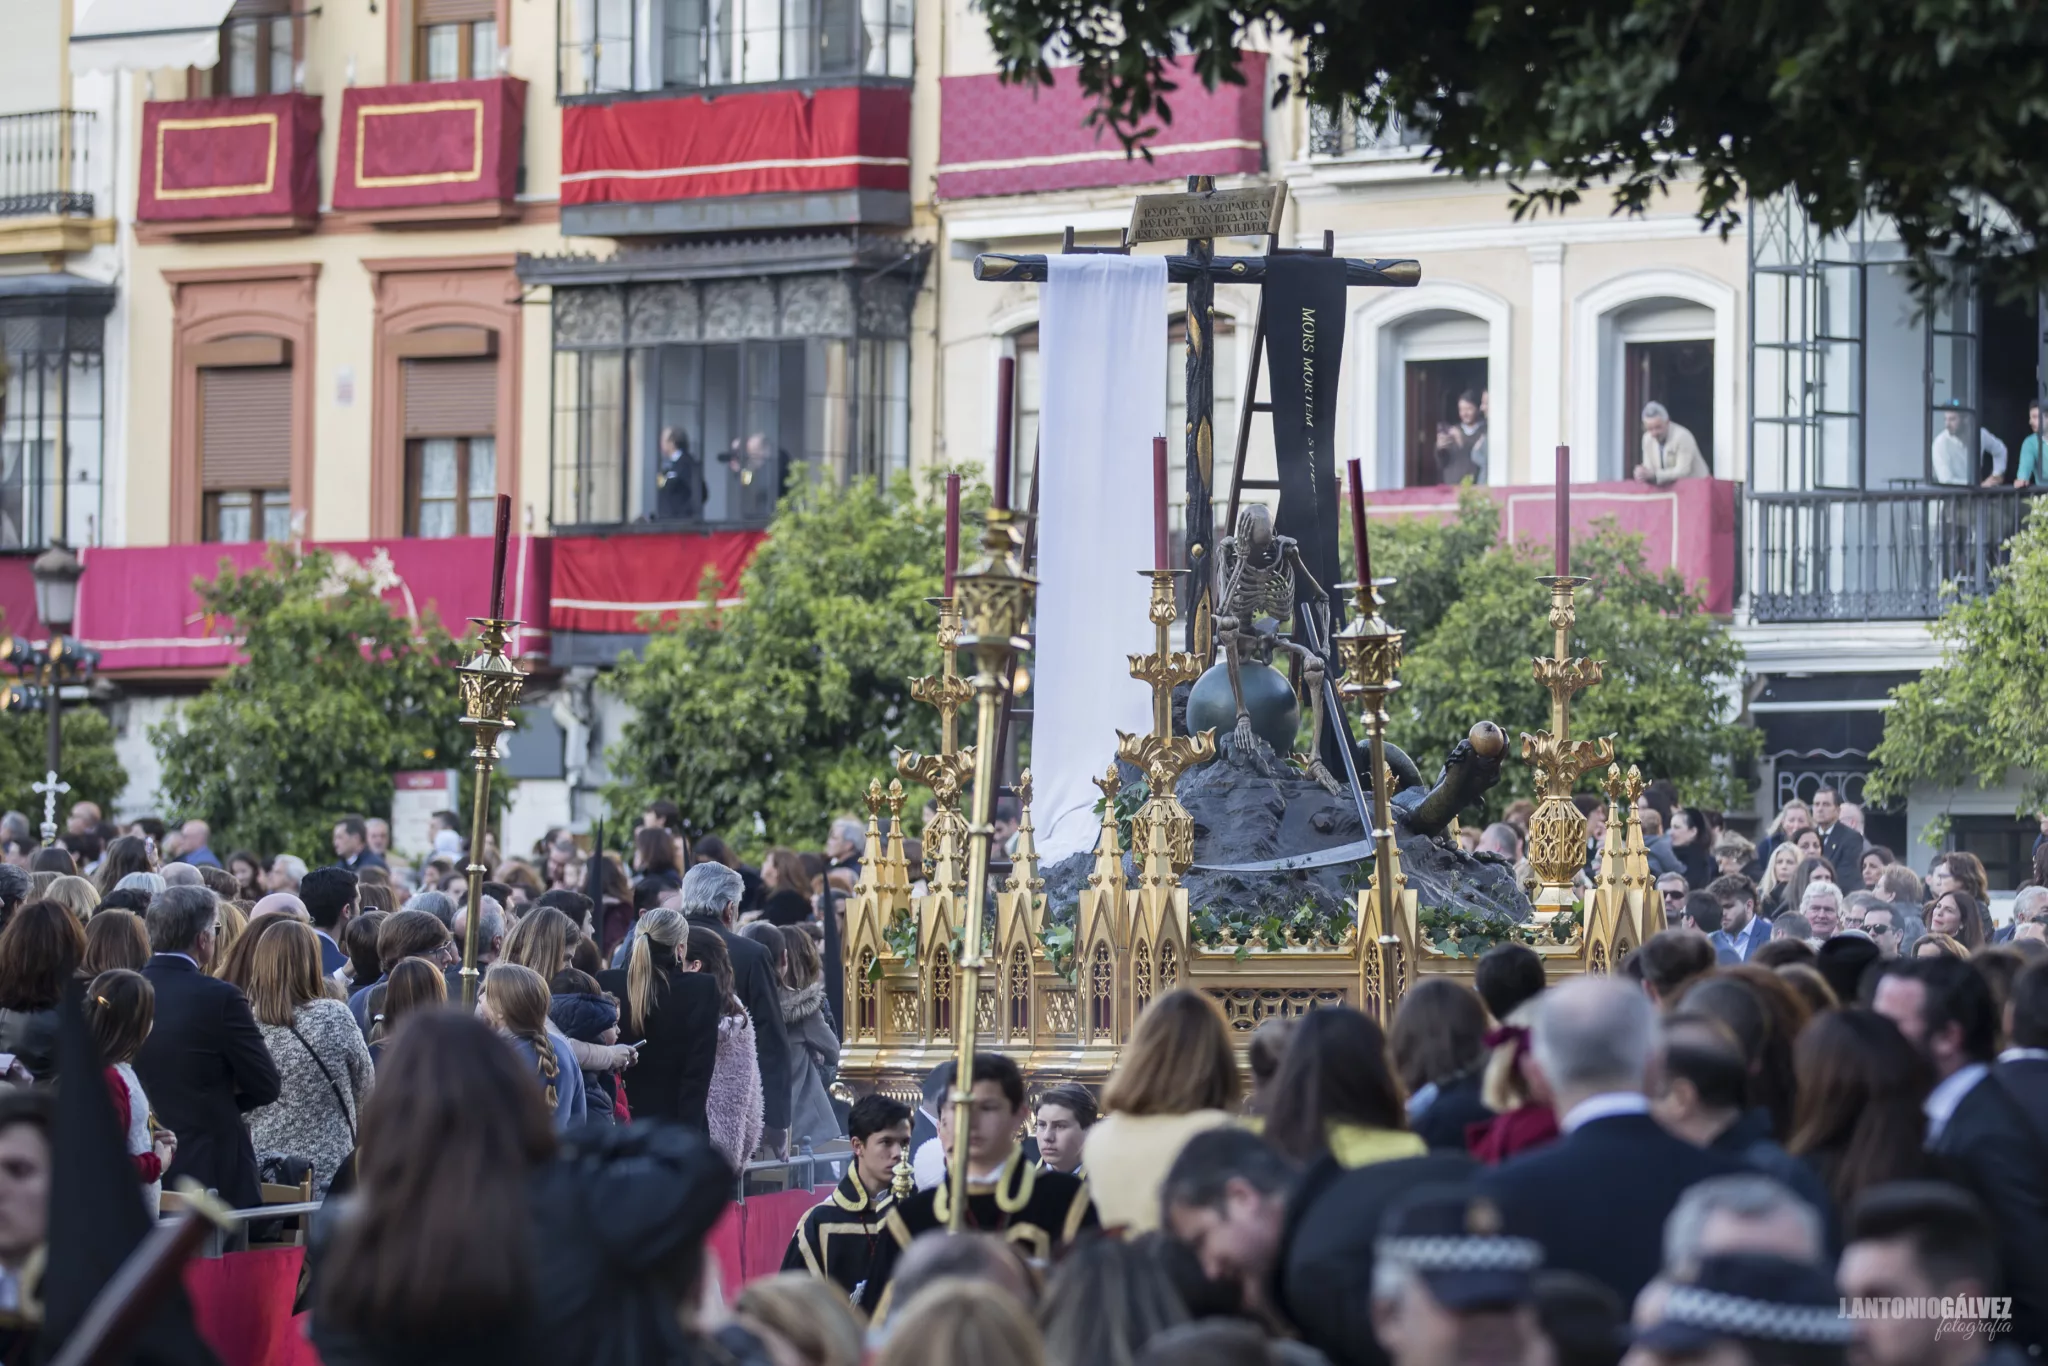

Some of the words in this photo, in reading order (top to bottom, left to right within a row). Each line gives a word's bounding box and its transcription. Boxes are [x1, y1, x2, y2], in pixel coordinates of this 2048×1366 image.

[1215, 223, 1232, 234] REX
[1302, 307, 1316, 353] MORS
[1303, 356, 1315, 428] MORTEM
